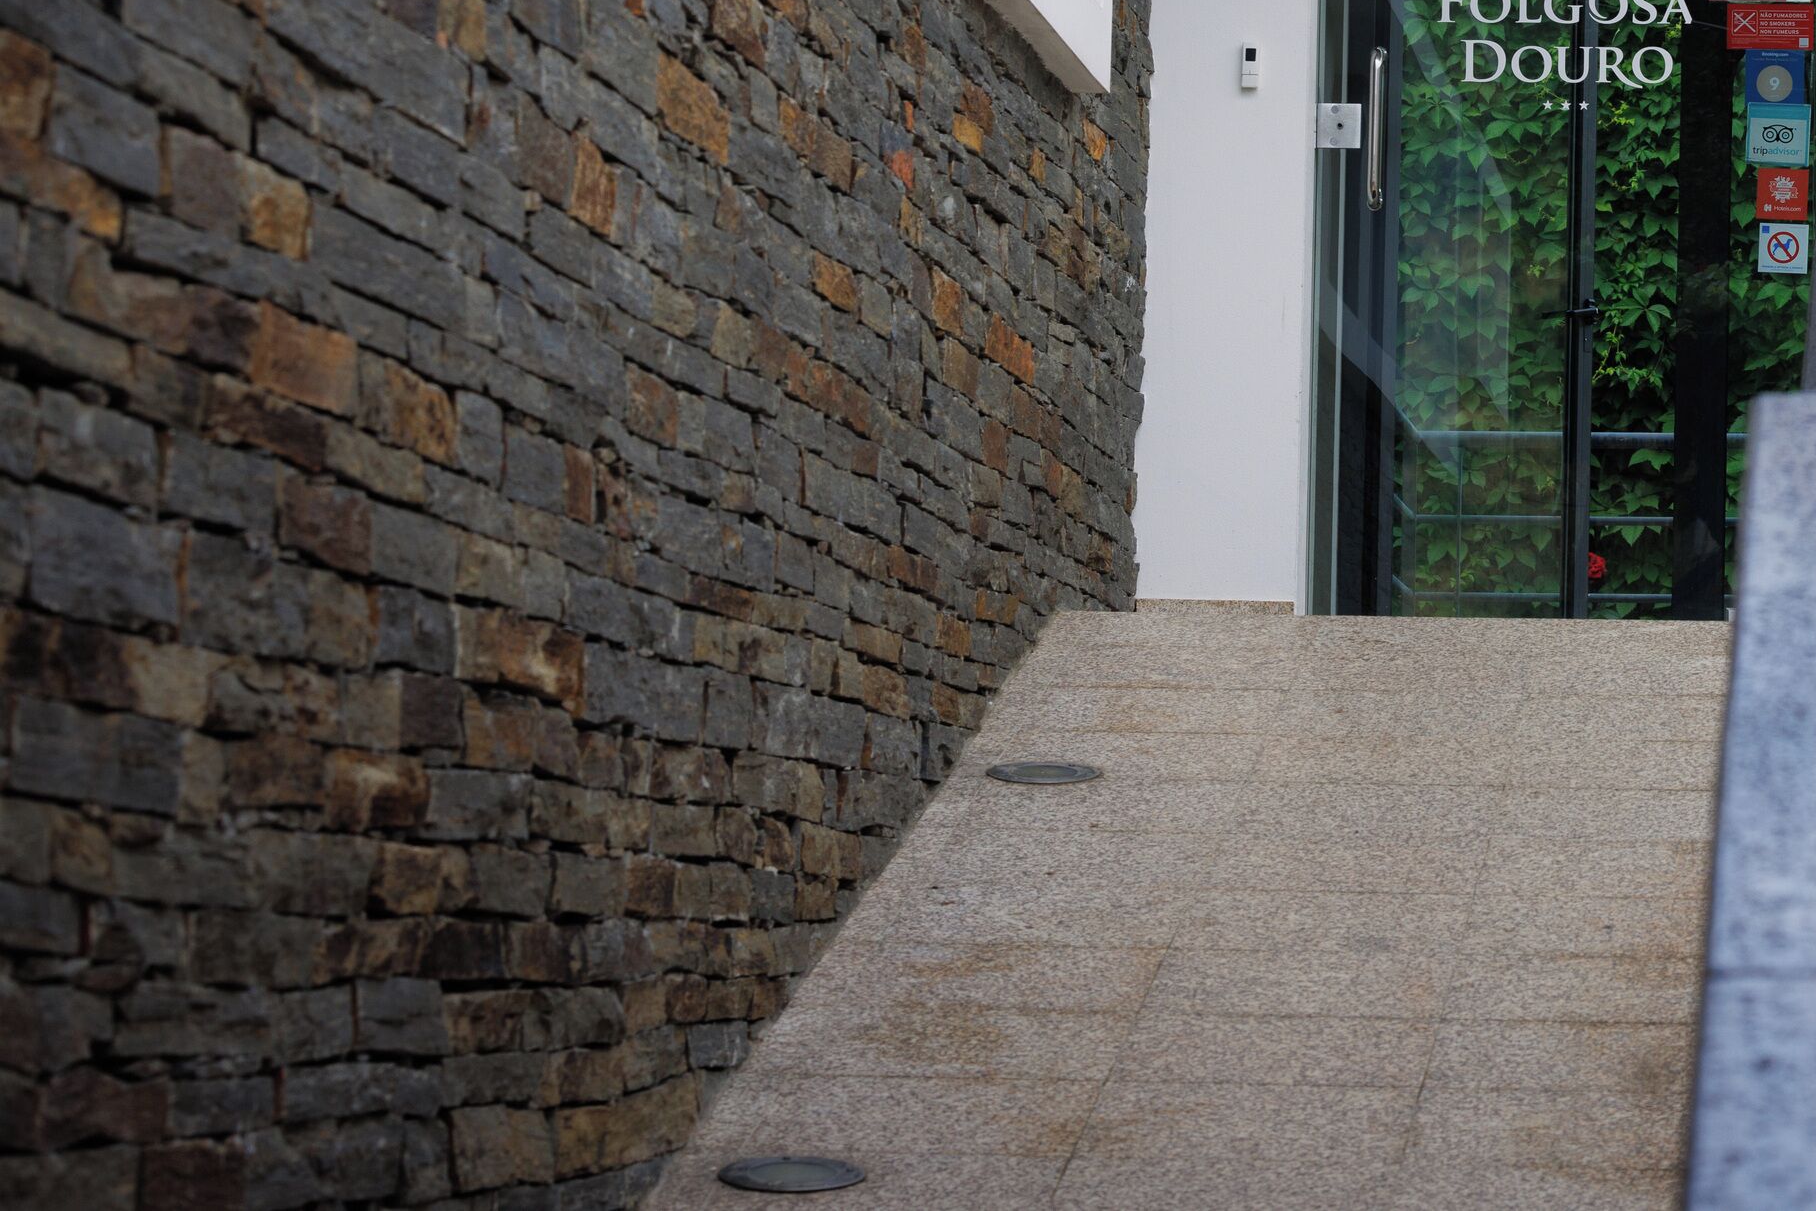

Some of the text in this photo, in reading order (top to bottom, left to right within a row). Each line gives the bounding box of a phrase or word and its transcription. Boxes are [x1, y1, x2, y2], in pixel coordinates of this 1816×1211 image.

[1460, 39, 1674, 89] DOURO
[1769, 76, 1780, 91] 9
[1752, 146, 1800, 156] tripadvisor
